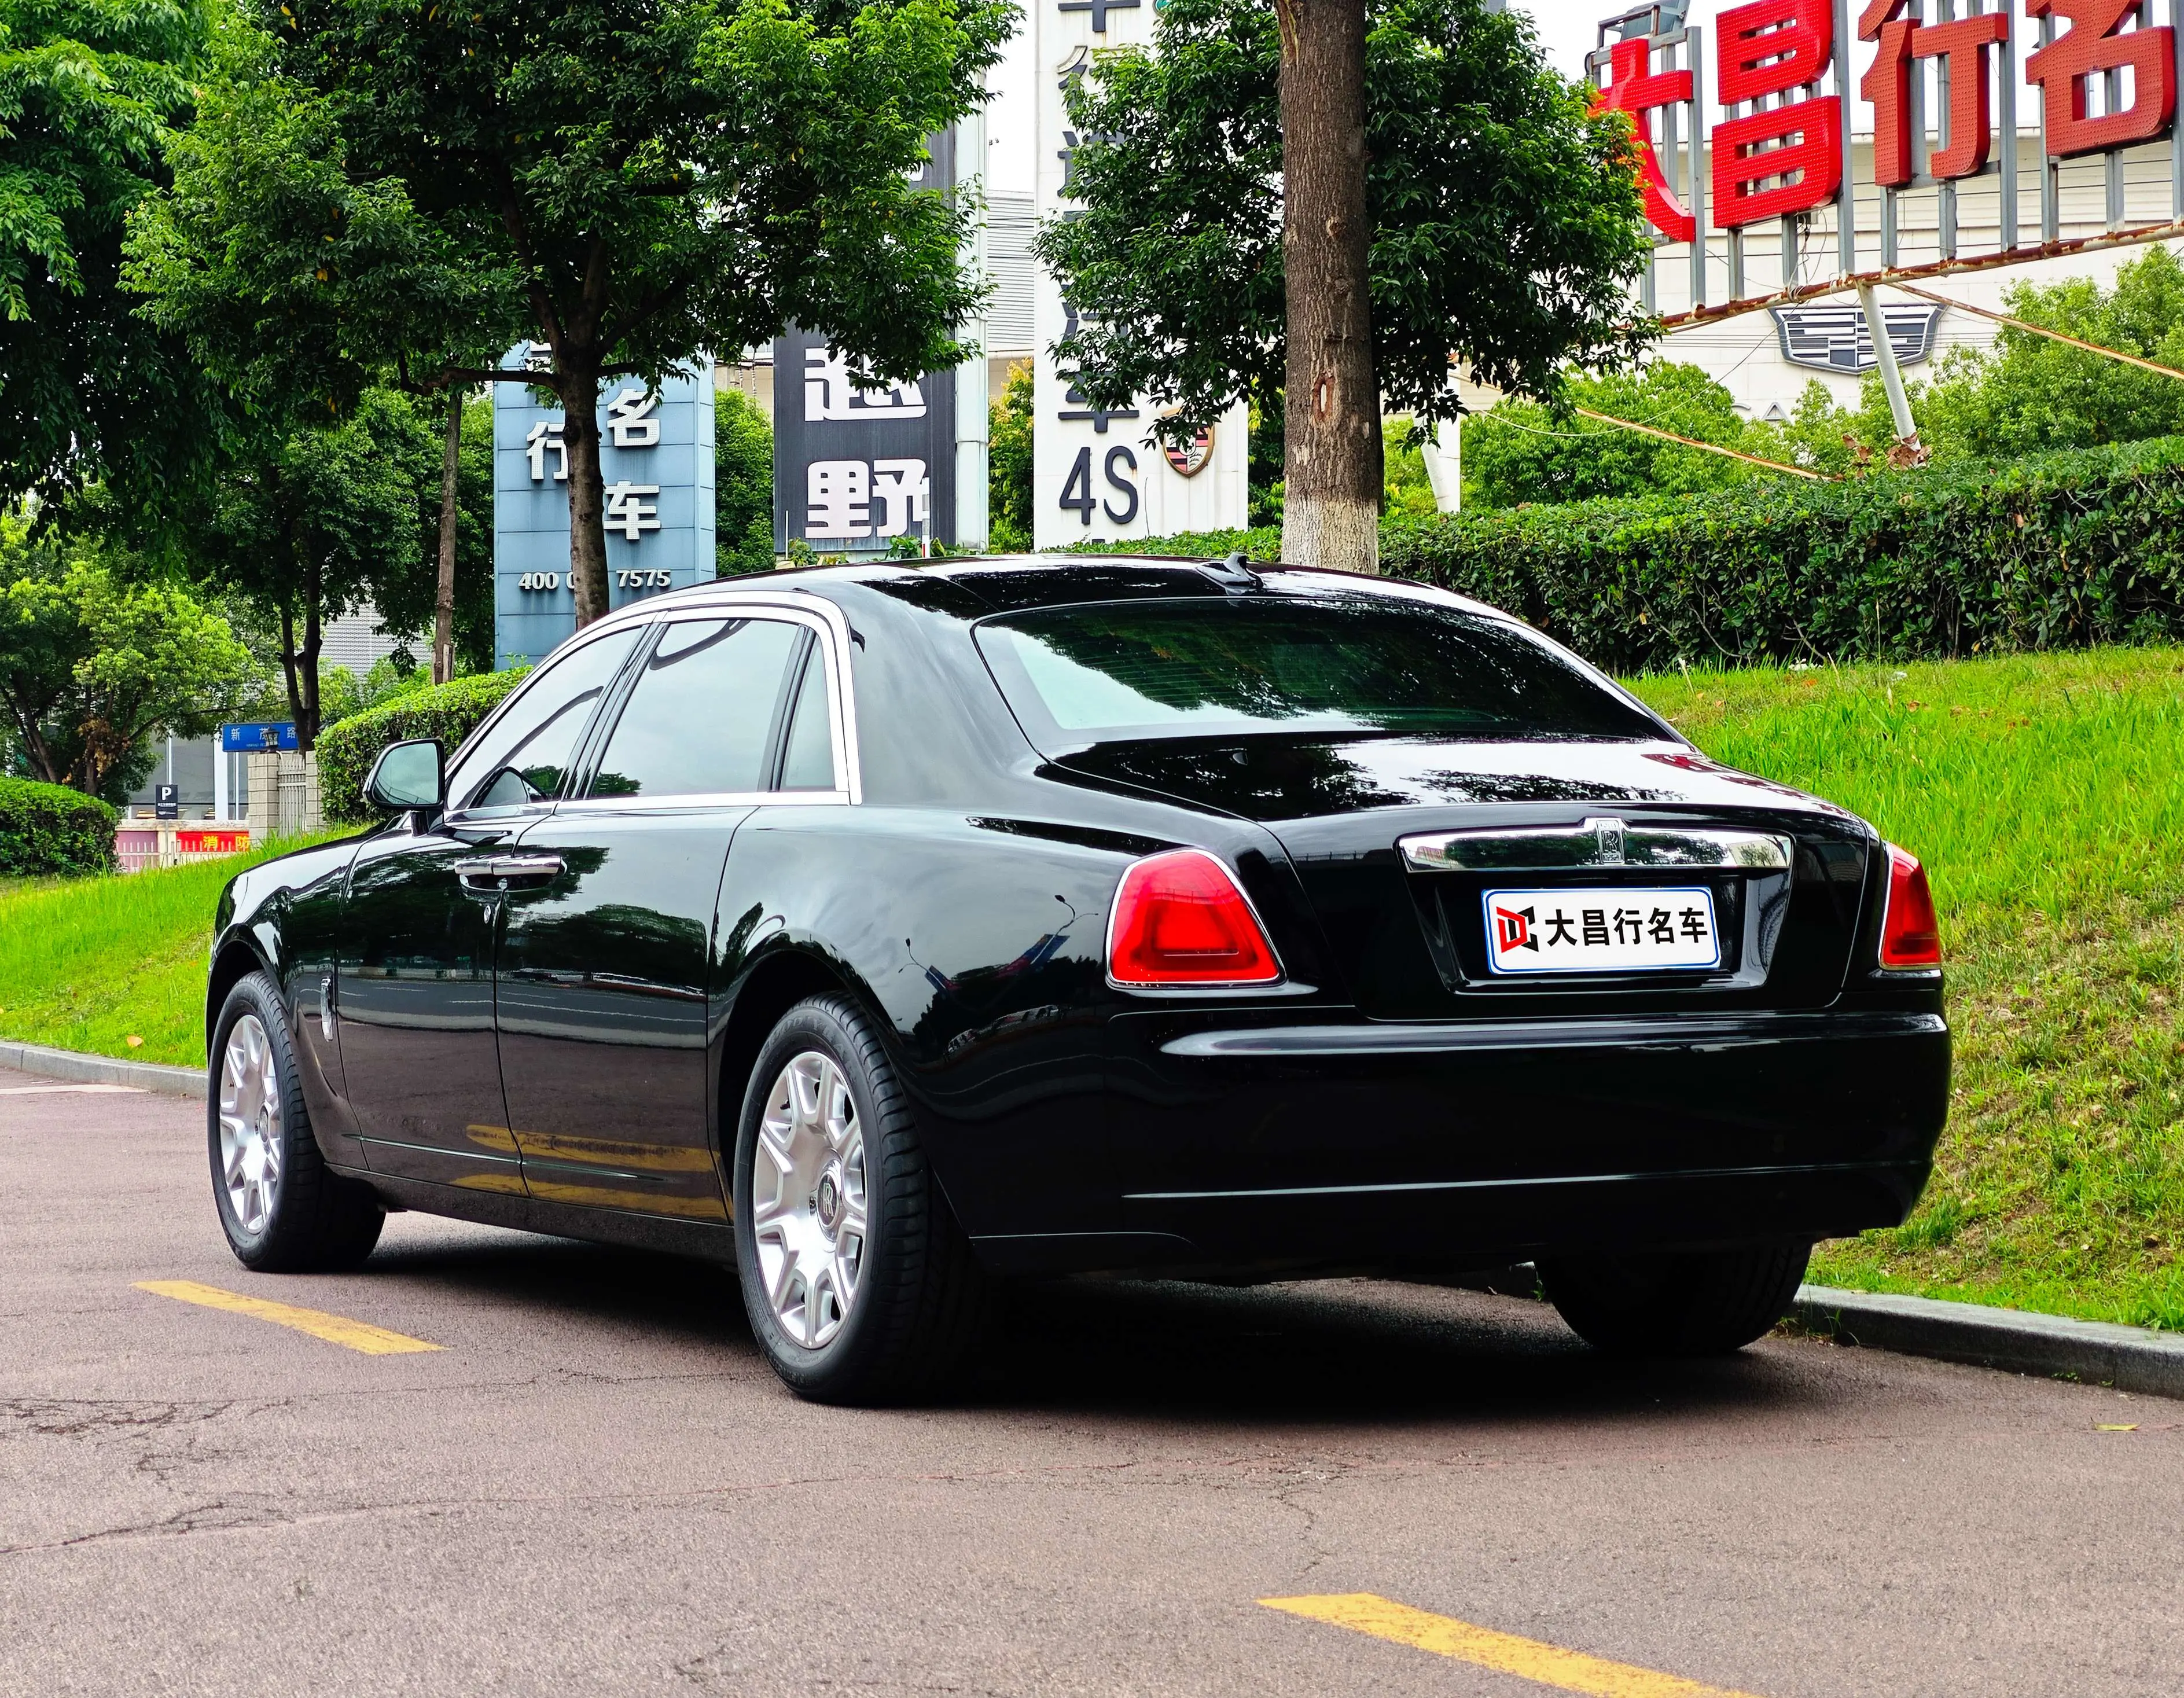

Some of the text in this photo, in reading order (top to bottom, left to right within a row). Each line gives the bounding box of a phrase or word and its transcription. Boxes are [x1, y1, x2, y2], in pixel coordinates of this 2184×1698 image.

[603, 388, 661, 540] 名车
[1059, 446, 1138, 525] 4S
[518, 572, 560, 590] 400
[616, 569, 671, 587] 7575
[161, 787, 172, 800] P
[203, 836, 250, 849] 消防
[1545, 907, 1708, 947] 大昌行名车
